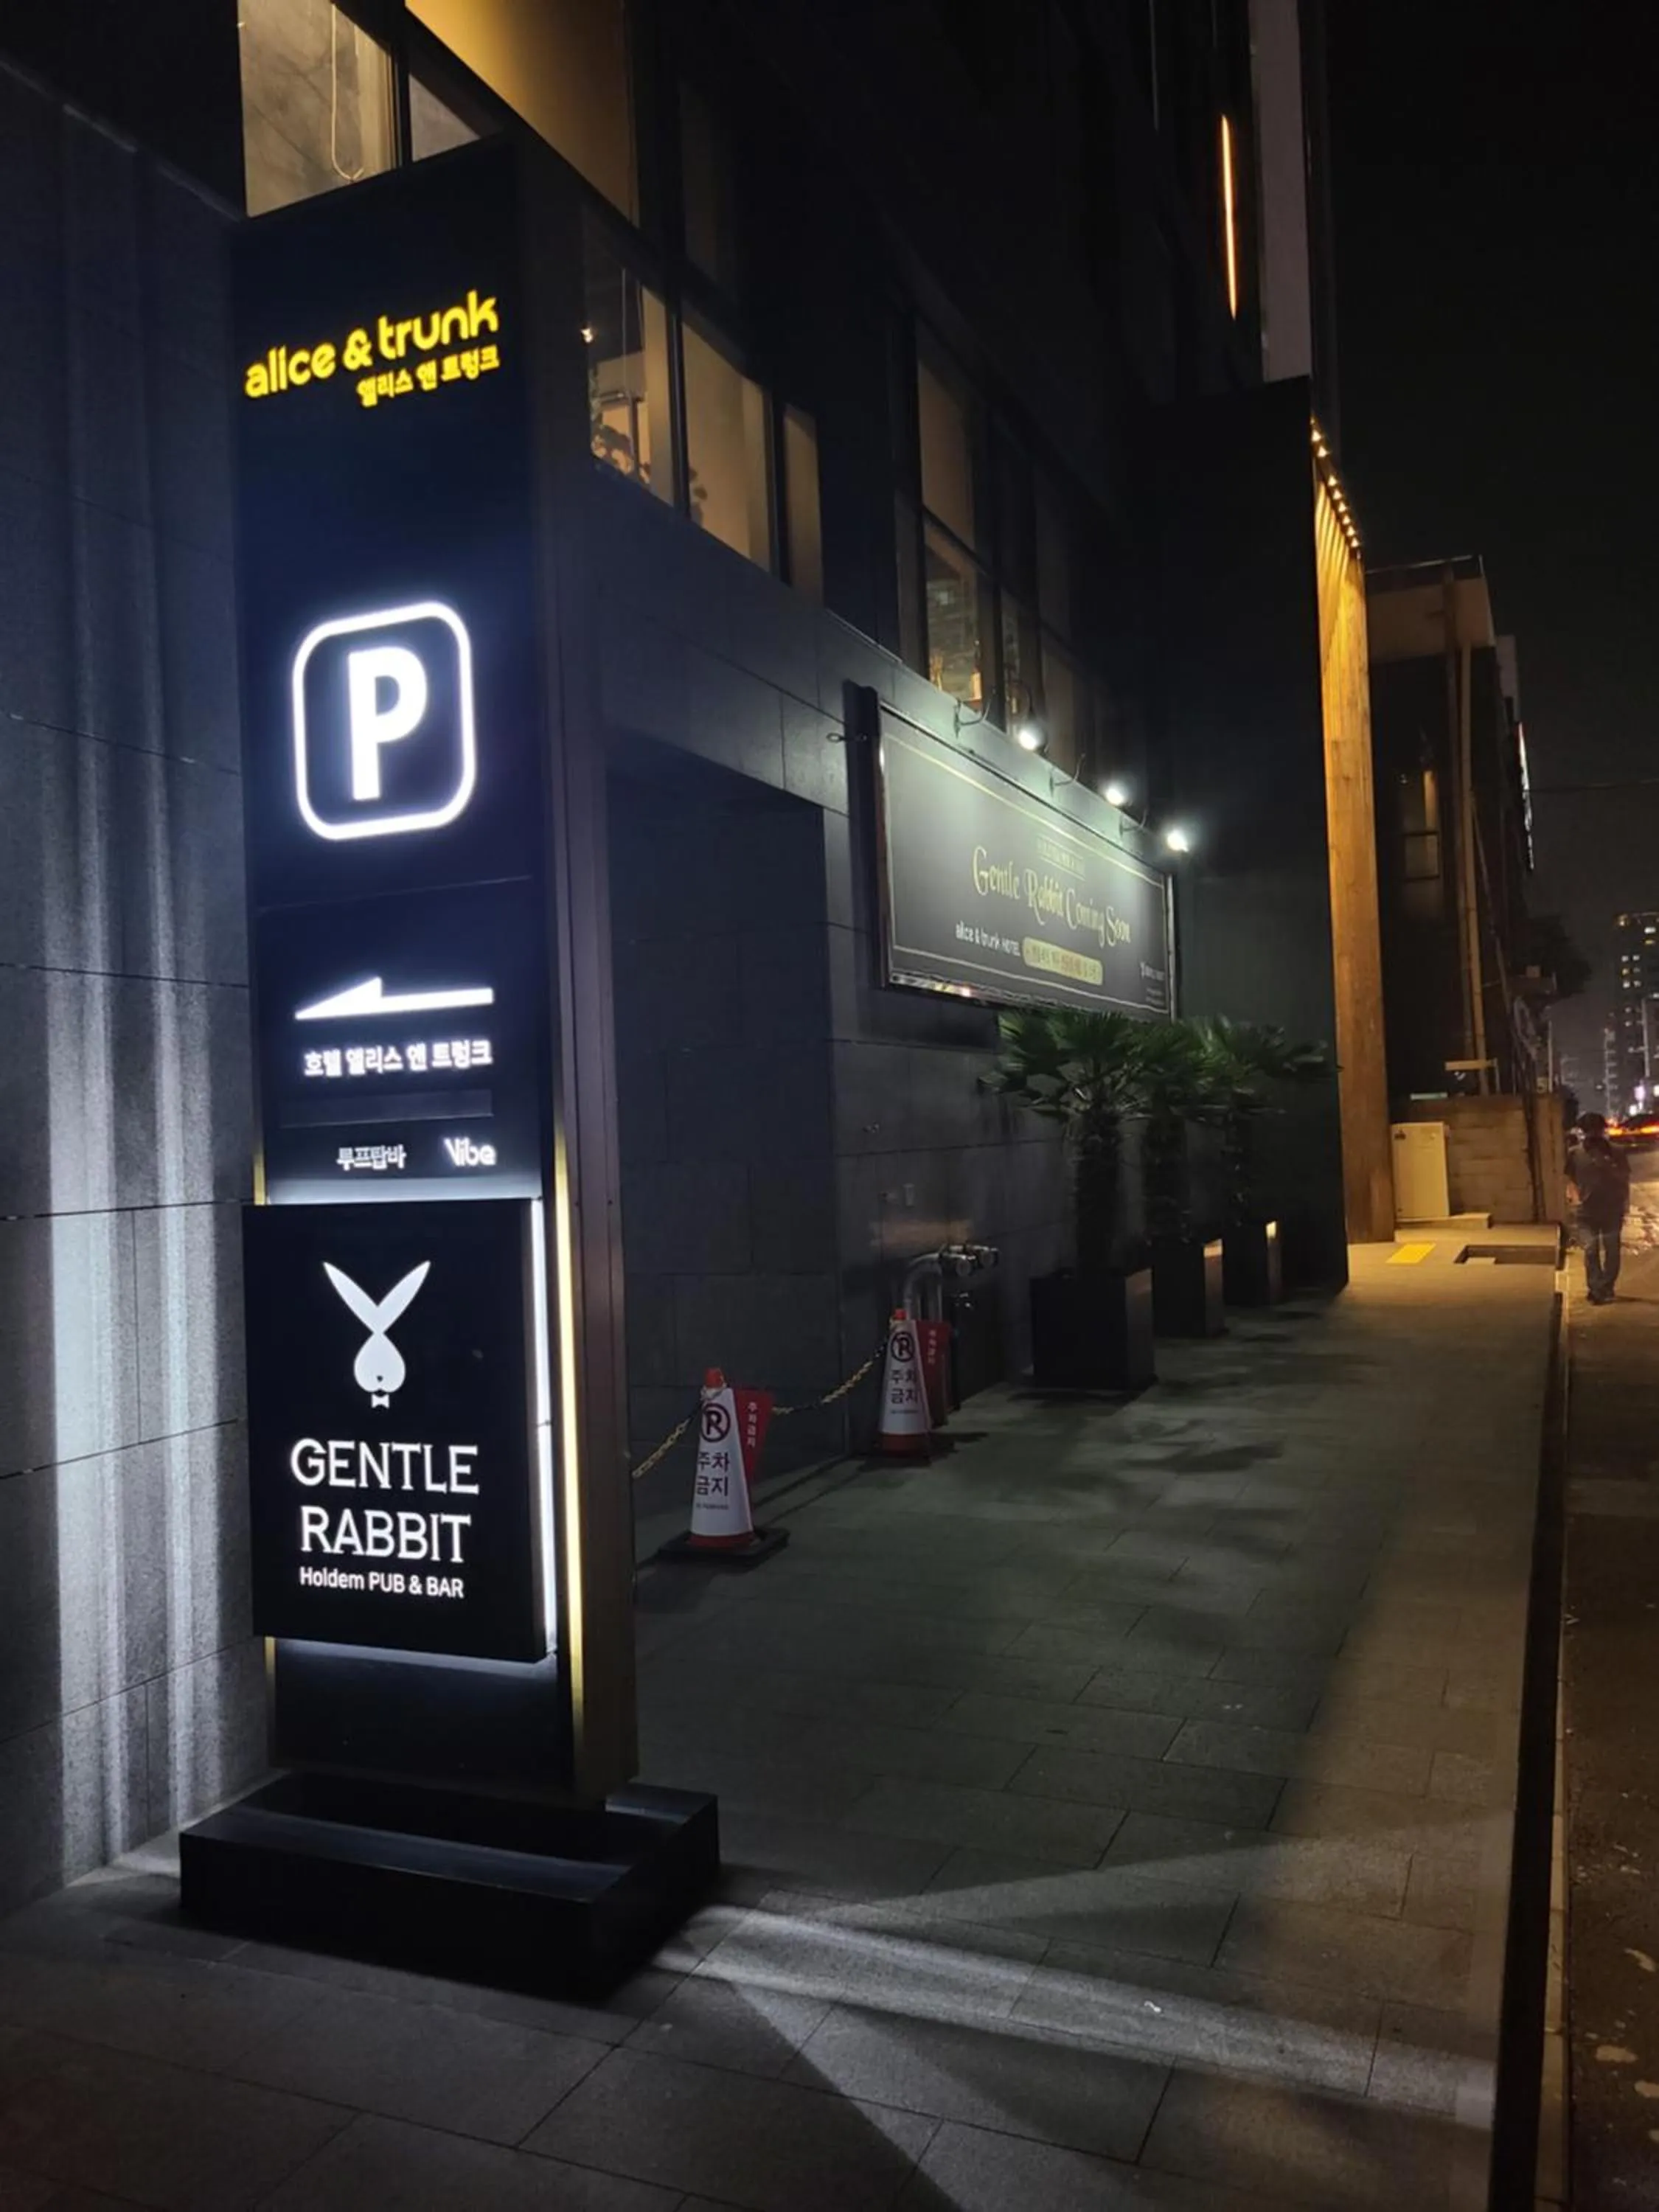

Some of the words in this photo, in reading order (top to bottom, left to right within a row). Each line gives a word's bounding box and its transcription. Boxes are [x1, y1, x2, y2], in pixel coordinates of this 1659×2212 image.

[246, 343, 336, 397] alice
[343, 328, 373, 371] &
[378, 290, 499, 360] trunk
[441, 344, 501, 382] 트렁크
[347, 646, 428, 801] P
[973, 846, 1020, 900] Gentle
[1023, 869, 1064, 926] Rabbit
[1066, 888, 1106, 949] Coming
[1106, 905, 1132, 947] Soon
[303, 1048, 343, 1078] 호텔
[431, 1039, 493, 1070] 트렁크
[335, 1144, 407, 1172] 루프탑바
[443, 1135, 498, 1167] Vibe
[290, 1438, 479, 1495] GENTLE
[698, 1451, 730, 1473] 주차
[697, 1475, 728, 1497] 금지
[300, 1505, 472, 1563] RABBIT
[299, 1567, 365, 1591] Holdem
[369, 1571, 406, 1594] PUB
[408, 1575, 423, 1596] &
[426, 1576, 465, 1599] BAR
